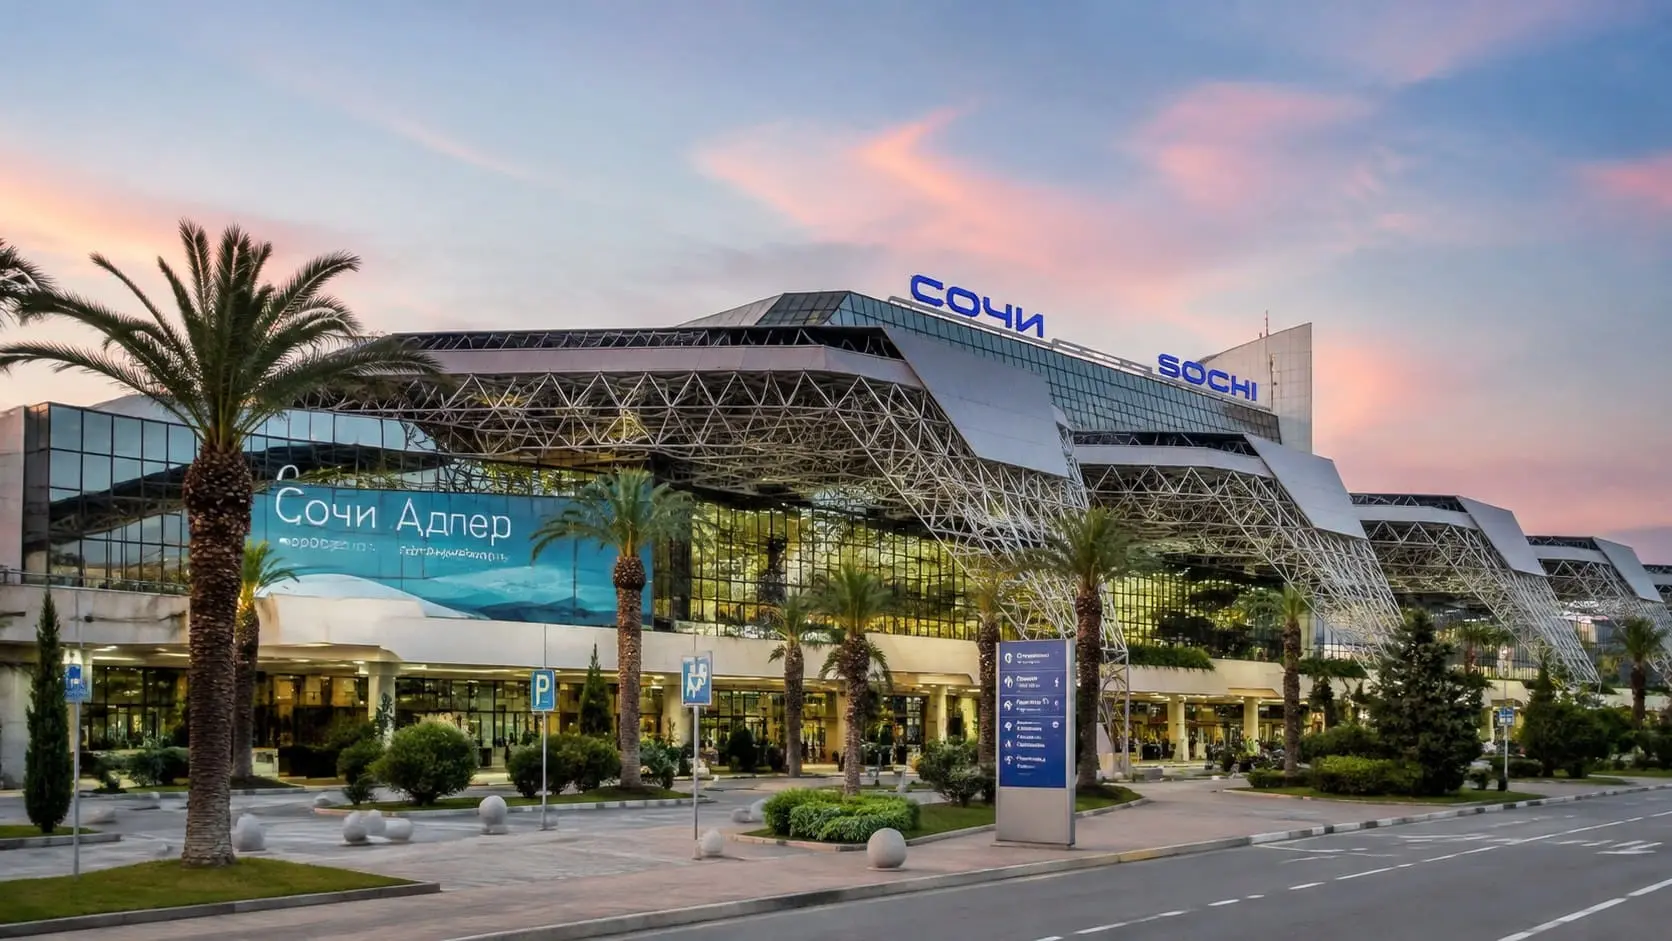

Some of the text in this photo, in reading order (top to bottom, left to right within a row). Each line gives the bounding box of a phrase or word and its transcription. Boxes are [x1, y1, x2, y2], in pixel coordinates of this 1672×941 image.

[910, 274, 1044, 338] СОЧИ
[1158, 353, 1257, 402] SOCHI
[275, 486, 376, 529] Сочи
[535, 674, 550, 707] P
